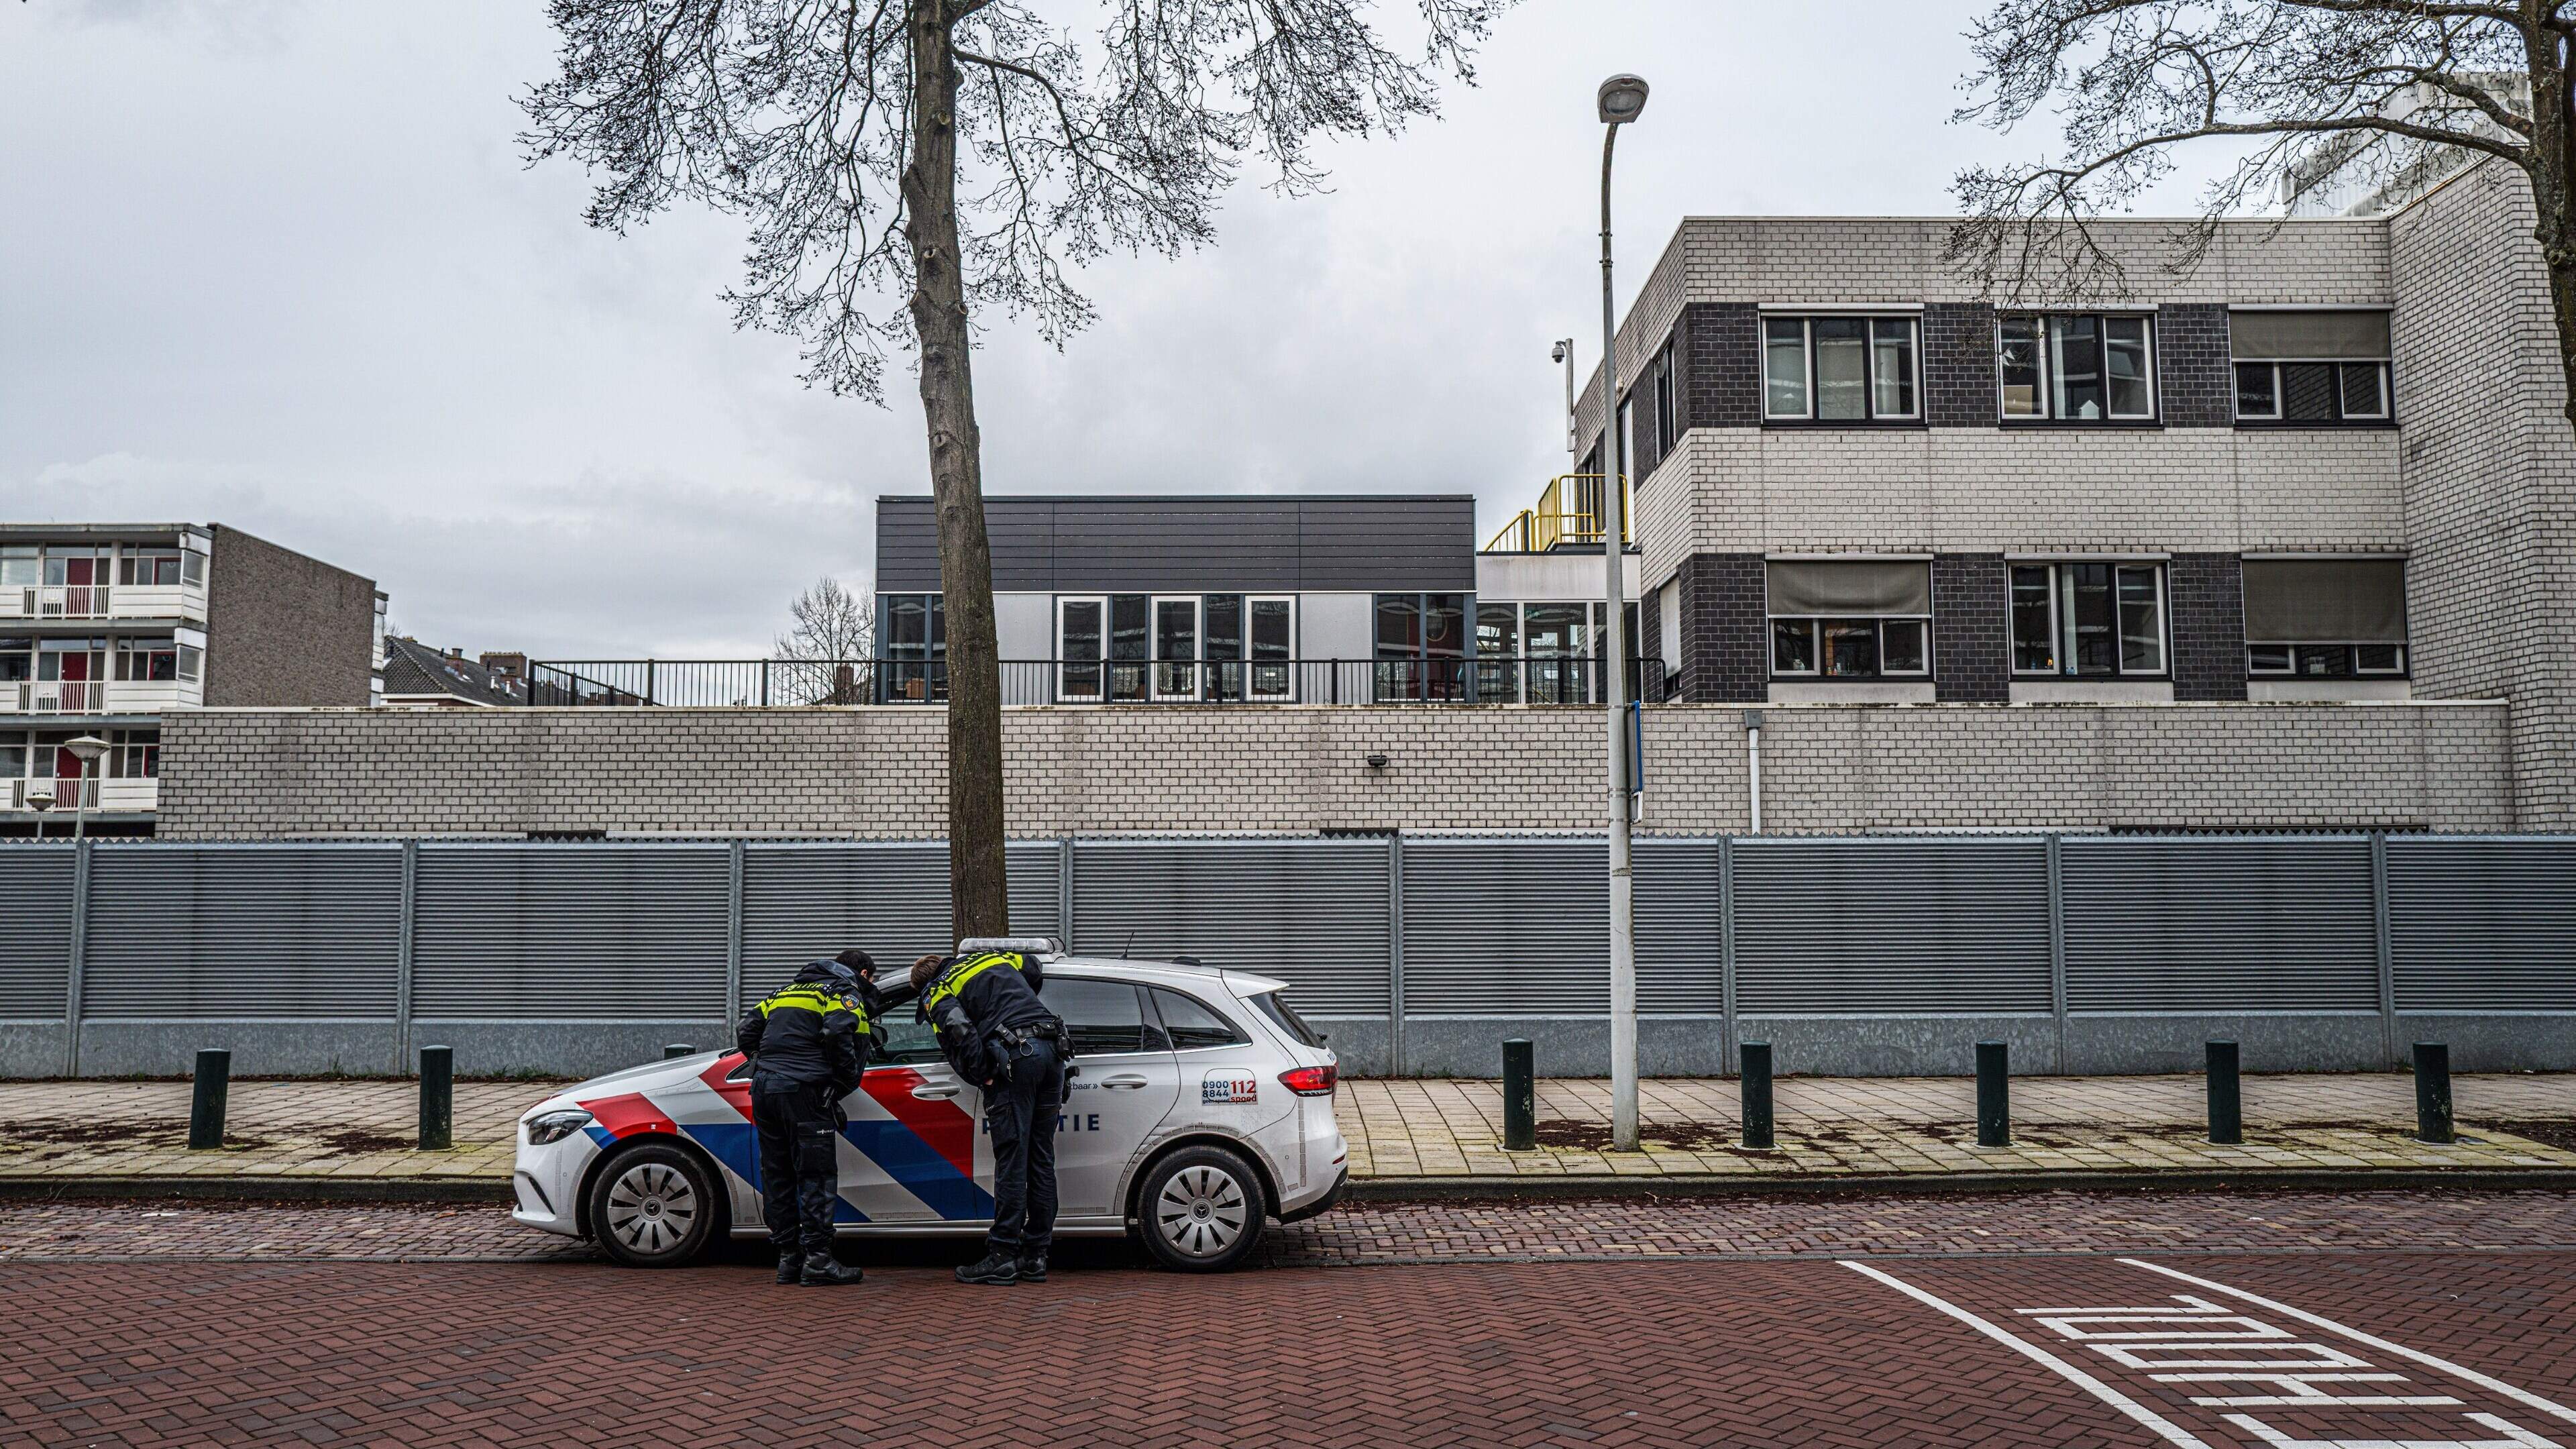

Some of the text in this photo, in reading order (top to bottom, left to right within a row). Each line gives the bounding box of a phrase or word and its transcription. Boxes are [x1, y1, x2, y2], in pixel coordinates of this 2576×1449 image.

[1202, 1081, 1229, 1089] 0900
[1230, 1080, 1256, 1094] 112
[1202, 1089, 1230, 1097] 8844
[1230, 1095, 1257, 1104] spoed
[982, 1114, 1100, 1134] PTIE
